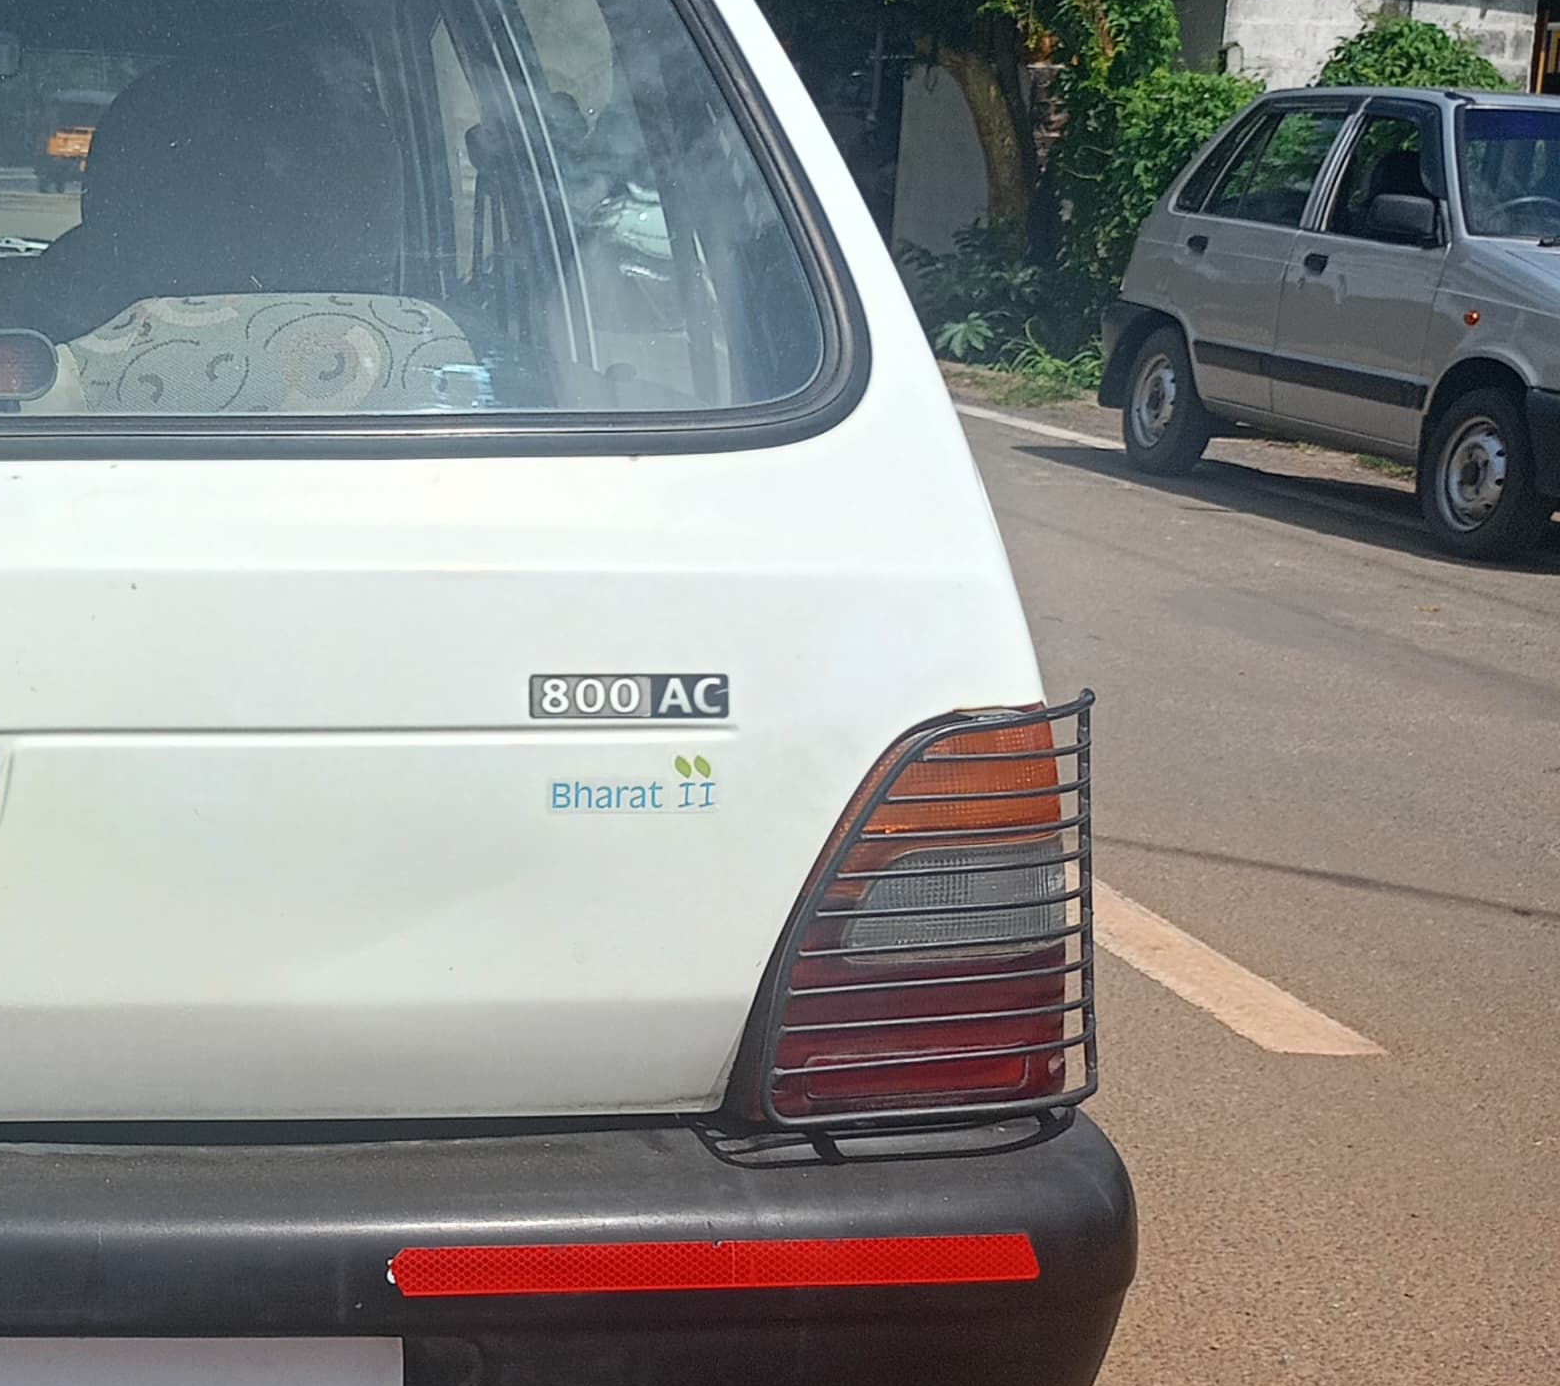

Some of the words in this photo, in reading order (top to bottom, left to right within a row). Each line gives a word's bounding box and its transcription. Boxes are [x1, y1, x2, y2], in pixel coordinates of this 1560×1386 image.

[541, 677, 641, 714] 800
[658, 677, 722, 714] AC
[551, 781, 663, 809] Bharat
